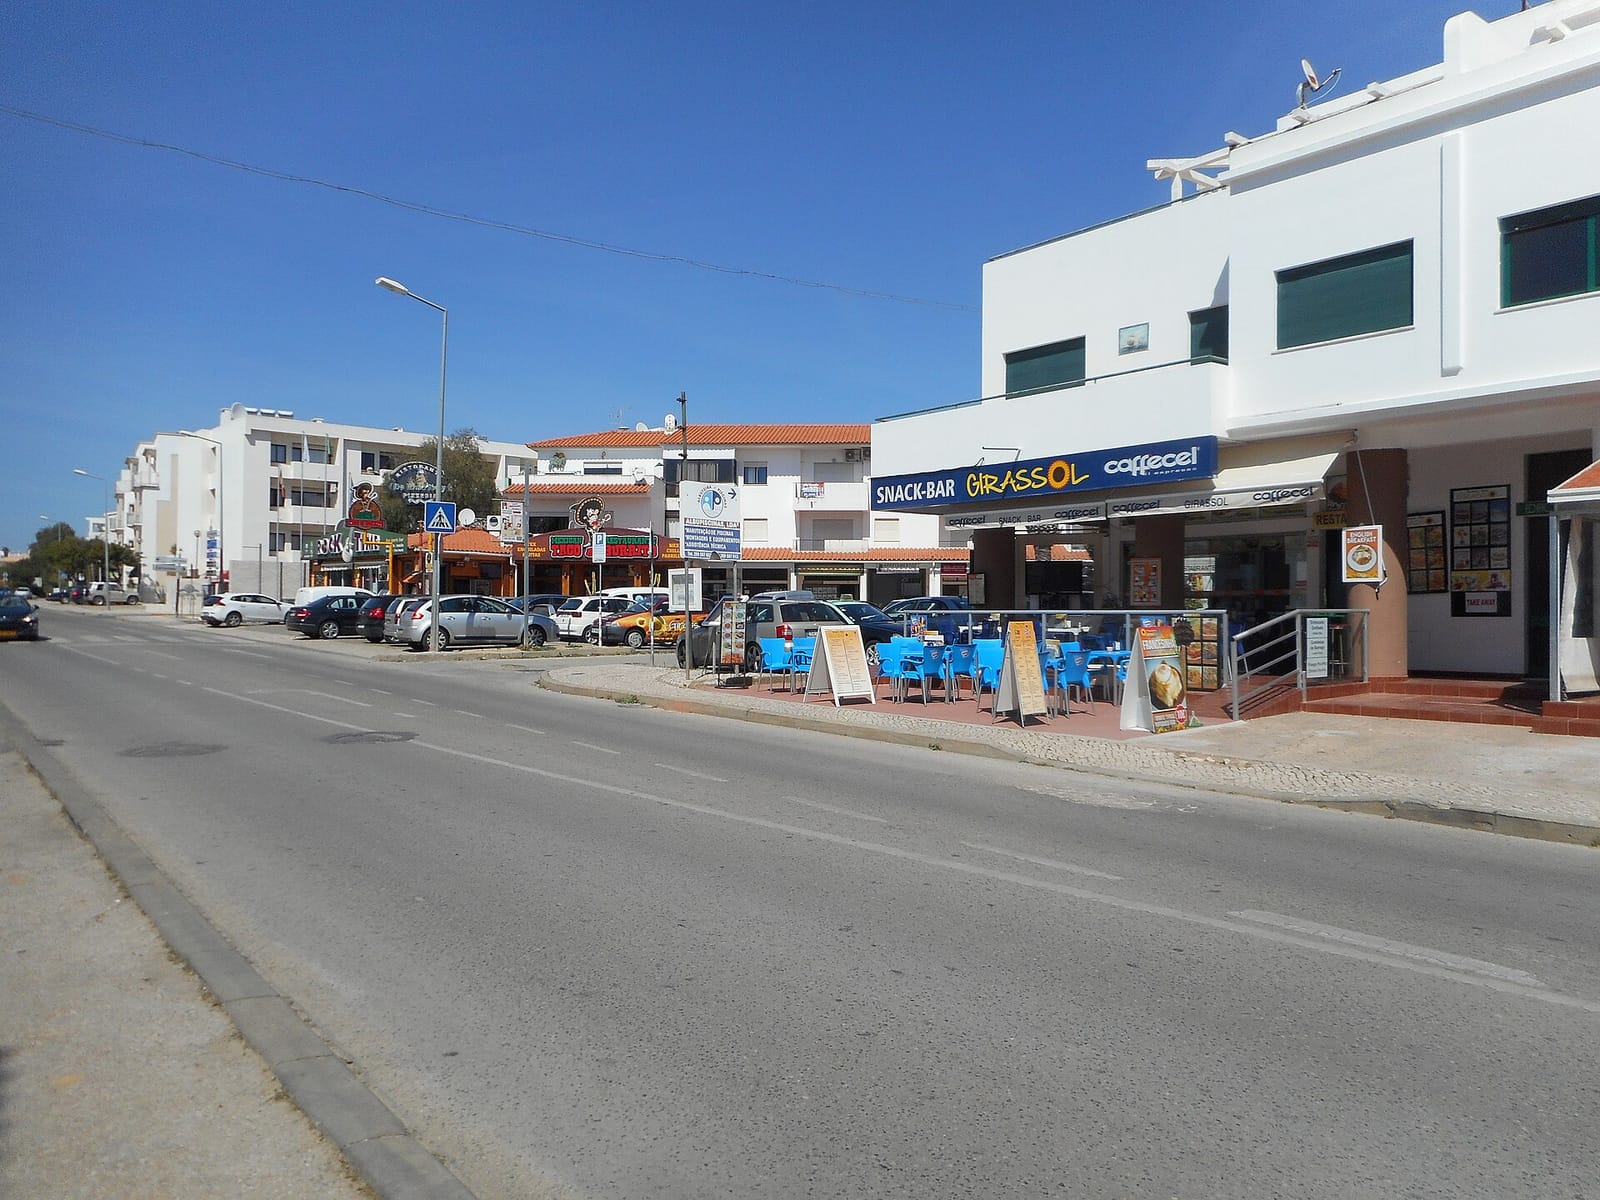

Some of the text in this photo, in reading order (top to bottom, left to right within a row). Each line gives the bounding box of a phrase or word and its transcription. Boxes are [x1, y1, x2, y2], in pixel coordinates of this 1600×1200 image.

[877, 460, 1091, 503] SNACK-BAR GIRASSOL
[1184, 497, 1228, 509] GIRASSOL
